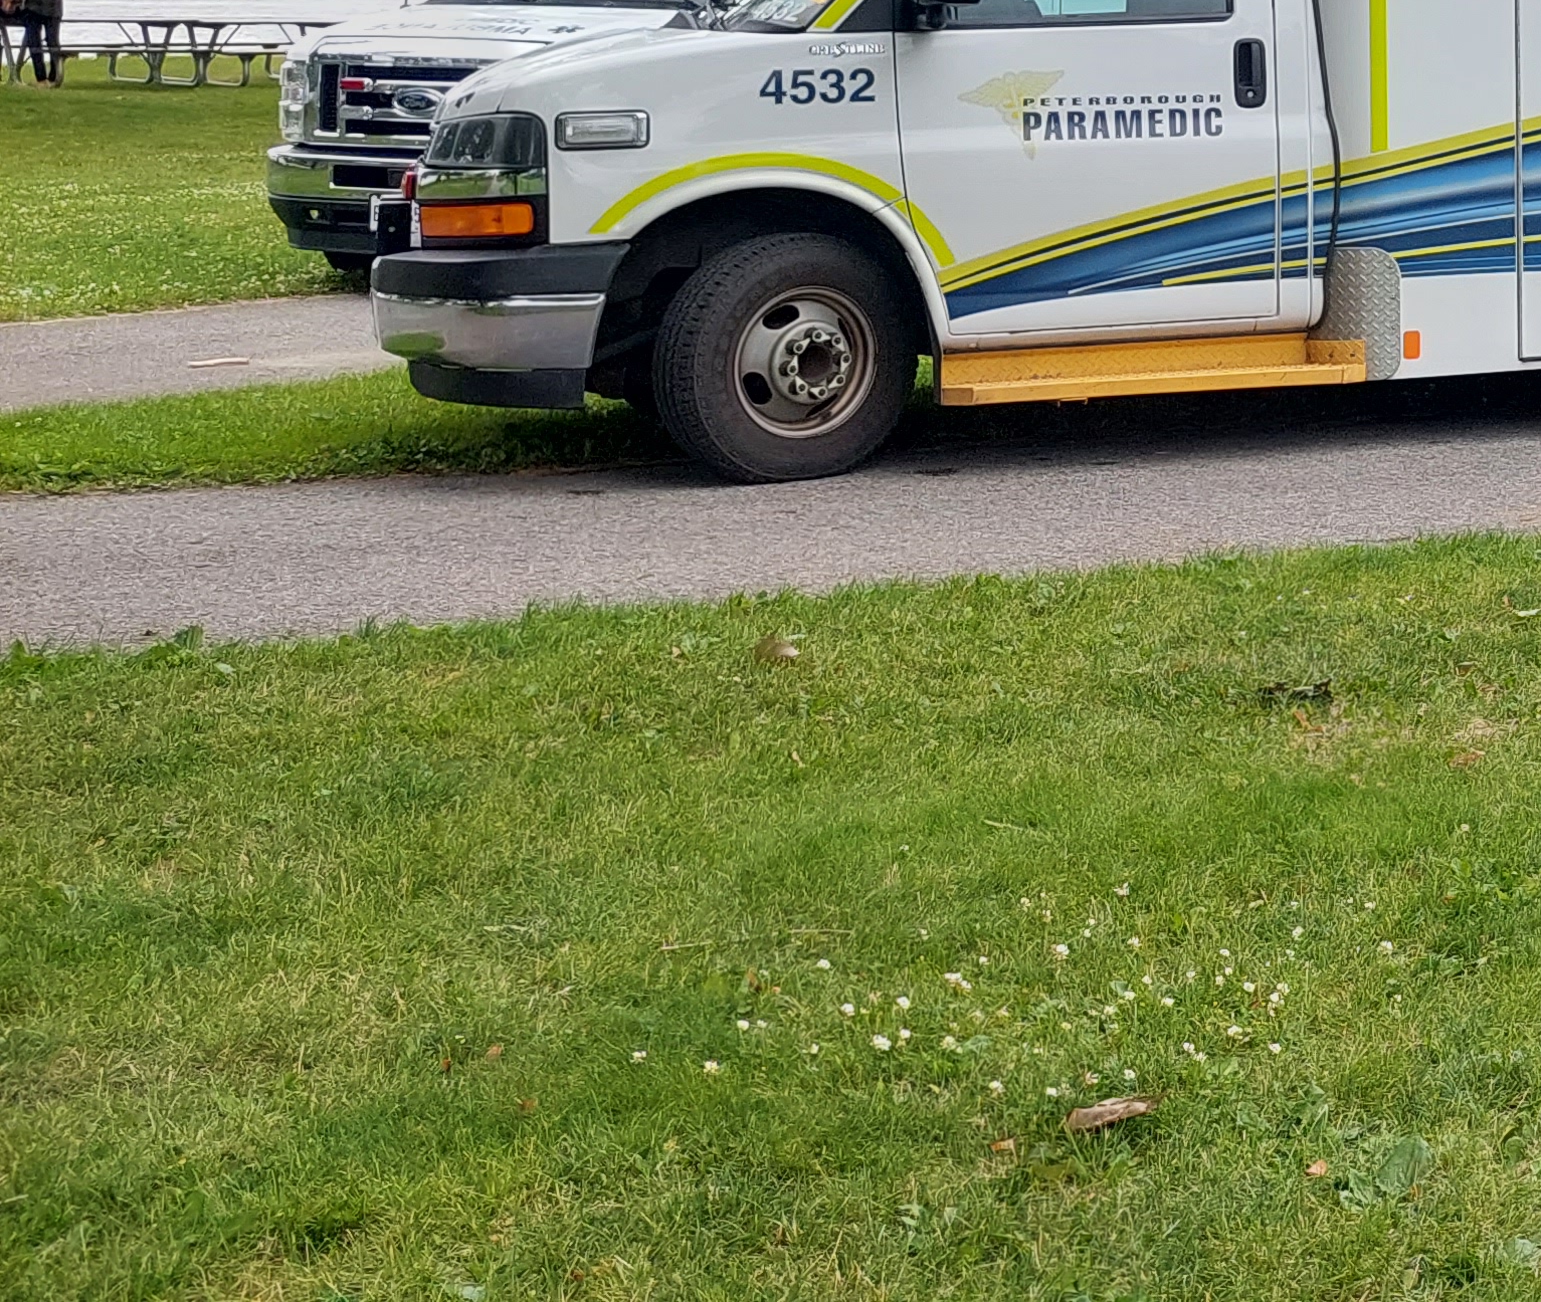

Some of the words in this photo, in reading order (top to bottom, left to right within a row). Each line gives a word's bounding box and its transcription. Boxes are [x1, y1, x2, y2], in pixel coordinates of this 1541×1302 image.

[759, 67, 876, 105] 4532
[1022, 94, 1222, 108] PETERBOROUGH
[1022, 107, 1224, 141] PARAMEDIC
